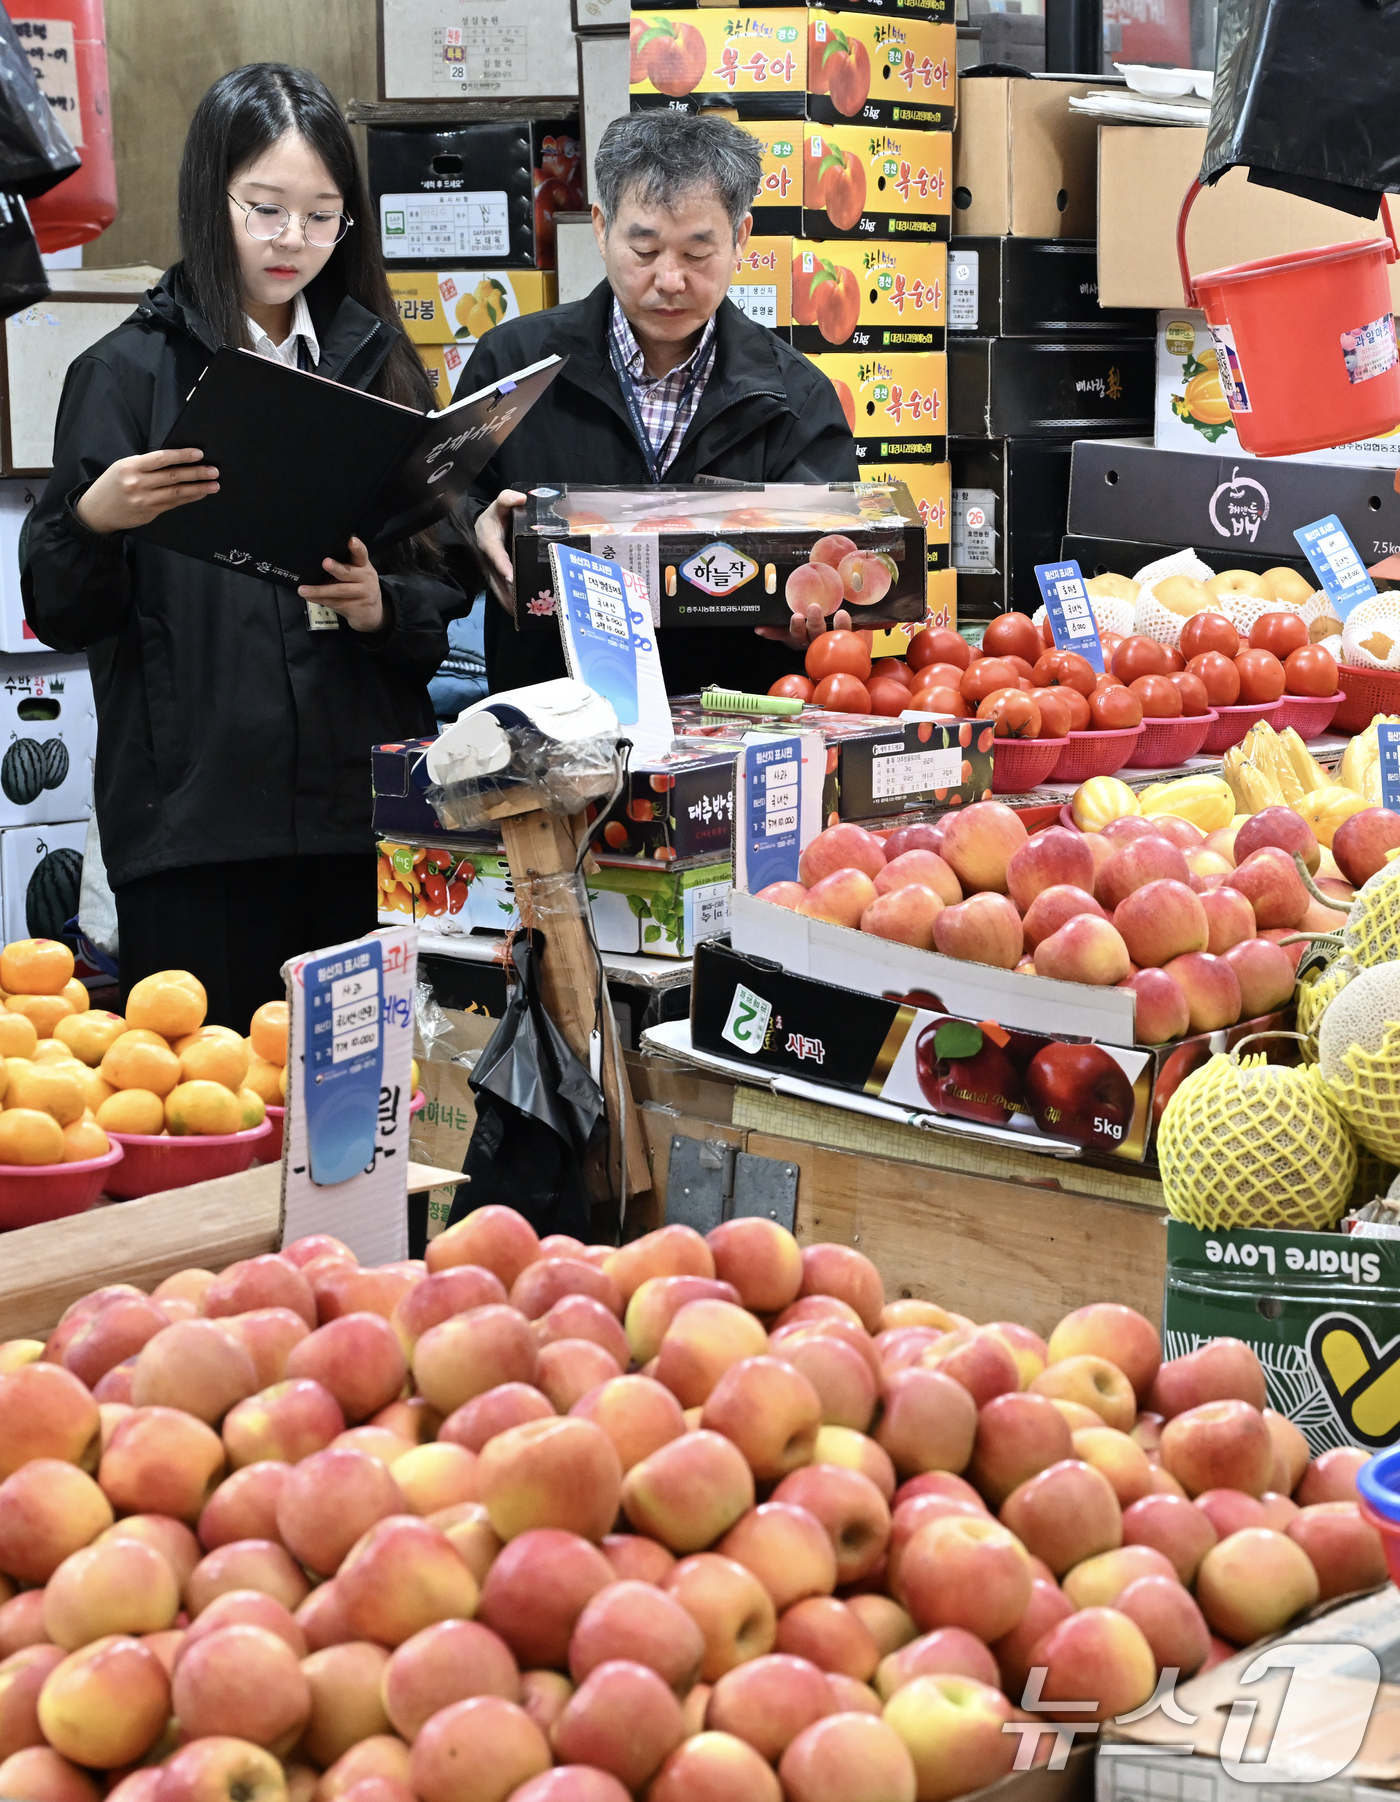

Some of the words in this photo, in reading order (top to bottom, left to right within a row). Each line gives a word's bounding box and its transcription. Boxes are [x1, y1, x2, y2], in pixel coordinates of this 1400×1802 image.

[777, 29, 797, 40] 경산
[888, 51, 902, 63] 경산
[452, 67, 464, 78] 28
[713, 46, 797, 88] 복숭아
[899, 48, 949, 91] 복숭아
[669, 101, 689, 111] 5kg
[863, 105, 880, 119] 5kg
[772, 144, 792, 156] 경산
[884, 162, 898, 175] 경산
[437, 180, 443, 188] 후
[893, 160, 945, 203] 복숭아
[859, 218, 876, 232] 5kg
[878, 275, 892, 288] 경산
[1079, 282, 1099, 295] 배사
[889, 273, 942, 315] 복숭아
[853, 332, 870, 346] 5kg
[873, 387, 888, 399] 경산
[1076, 378, 1105, 398] 배사랑
[885, 384, 941, 426] 복숭아
[854, 443, 867, 457] kg
[918, 498, 947, 529] 숭아
[969, 511, 982, 525] 26
[1232, 516, 1261, 542] 배
[569, 553, 591, 569] 원산지
[591, 561, 613, 577] 표시판
[693, 555, 746, 587] 하늘작
[755, 750, 773, 765] 원산지
[774, 746, 793, 761] 표시판
[773, 770, 788, 781] 사과
[771, 793, 789, 808] 국내산
[695, 827, 727, 840] CHERRY
[700, 908, 731, 923] 미숙
[316, 962, 343, 983] 원산지
[344, 952, 370, 975] 표시판
[733, 1001, 758, 1041] 2
[785, 1033, 826, 1064] 사과
[949, 1084, 989, 1104] Natural
[1044, 1106, 1062, 1124] Gift
[1093, 1117, 1123, 1139] 5kg
[1205, 1240, 1276, 1276] Love
[1285, 1247, 1381, 1284] Share
